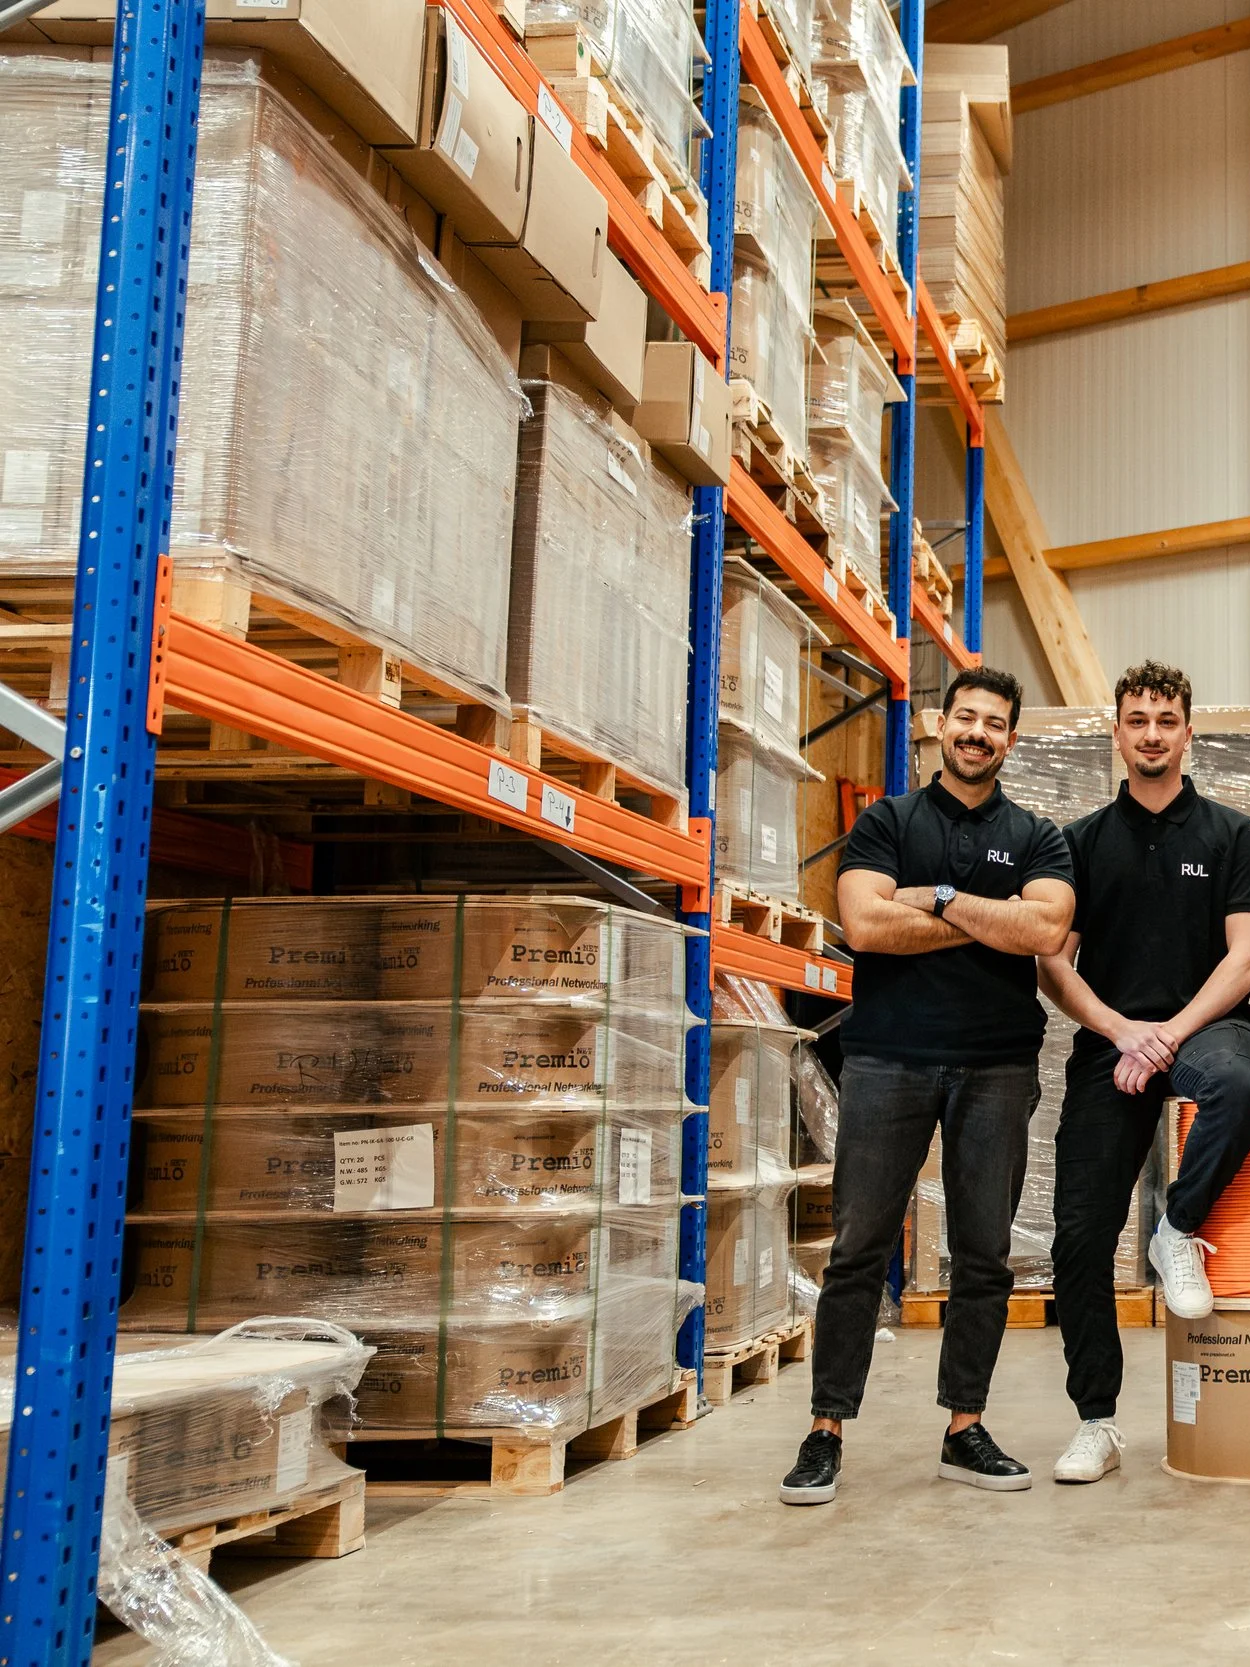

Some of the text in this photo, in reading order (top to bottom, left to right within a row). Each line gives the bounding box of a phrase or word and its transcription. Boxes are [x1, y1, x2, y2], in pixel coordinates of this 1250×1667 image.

[497, 767, 516, 793] P-3
[547, 791, 565, 818] P-4
[987, 849, 1015, 866] RUL
[1181, 863, 1209, 877] RUL
[511, 944, 598, 965] Premio NET
[487, 975, 559, 988] Professional
[503, 1049, 589, 1069] Premio
[511, 1152, 592, 1171] Premio
[806, 1203, 832, 1214] Pre
[1187, 1332, 1242, 1345] Professional
